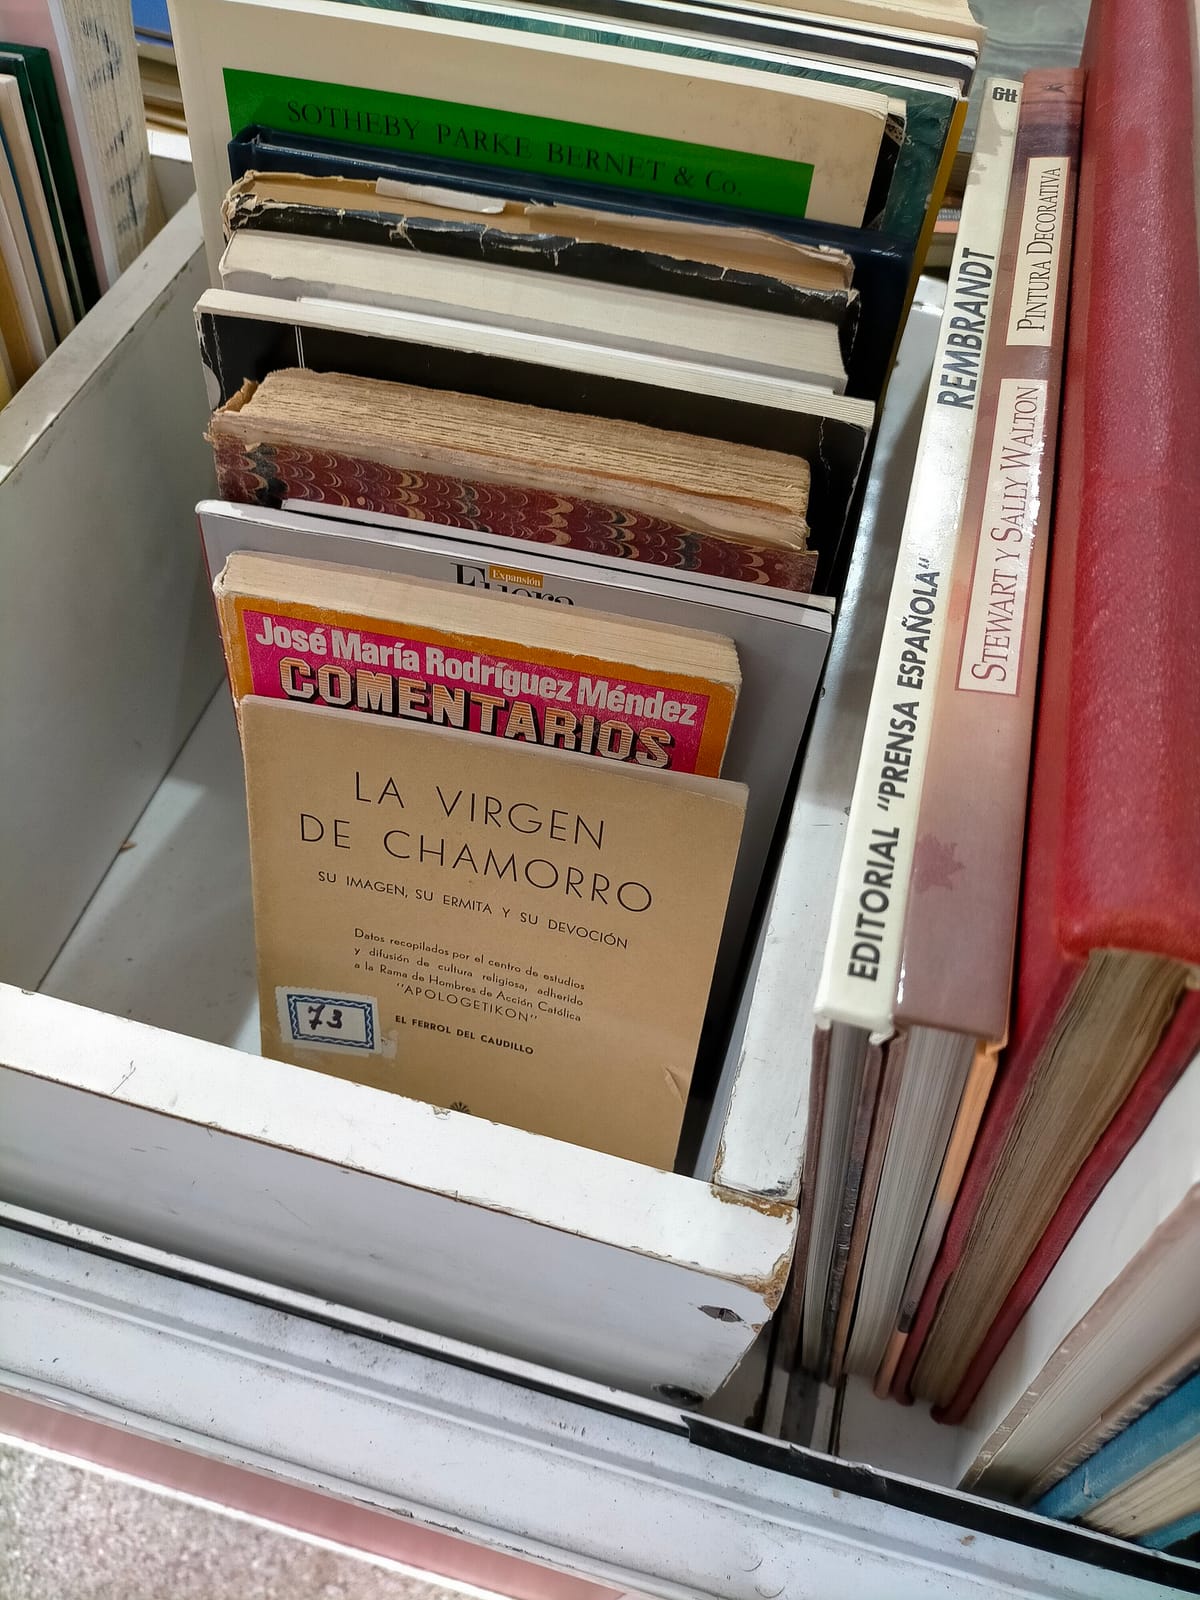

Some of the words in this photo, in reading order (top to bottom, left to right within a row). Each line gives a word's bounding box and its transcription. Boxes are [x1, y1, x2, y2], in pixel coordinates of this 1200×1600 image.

[287, 100, 421, 140] SOTHEBY
[434, 123, 531, 160] PARKE
[547, 142, 666, 181] BERNET
[673, 166, 694, 188] &
[705, 169, 742, 197] Co.
[1026, 167, 1061, 255] DECORATIVA
[937, 247, 995, 410] REMBRANDT
[1016, 260, 1051, 331] PINTURA
[999, 386, 1039, 471] WALTON
[990, 477, 1029, 543] SALLY
[492, 568, 541, 587] Expansión
[994, 548, 1020, 567] Y
[971, 568, 1018, 682] STEWART
[255, 616, 327, 656] José
[331, 629, 420, 673] María
[426, 646, 573, 703] Rodríguez
[577, 676, 698, 726] Méndez
[279, 656, 675, 769] COMENTARIOS
[355, 771, 405, 809] LA
[436, 785, 605, 850] VIRGEN
[300, 813, 351, 850] DE
[383, 829, 653, 913] CHAMORRO
[318, 871, 337, 883] SU
[346, 875, 408, 899] IMAGEN,
[415, 889, 434, 902] SU
[443, 894, 493, 915] ERMITA
[502, 906, 511, 919] Y
[520, 911, 538, 925] SU
[548, 919, 628, 950] DEVOCIÓN
[847, 827, 900, 982] EDITORIAL
[354, 927, 385, 944] Datos
[390, 938, 449, 956] recopilados
[452, 950, 470, 961] por
[474, 953, 484, 964] el
[488, 959, 521, 974] centro
[525, 965, 539, 978] de
[543, 973, 585, 991] estudios
[354, 947, 361, 956] y
[369, 947, 410, 963] difusión
[416, 956, 430, 968] de
[438, 963, 473, 978] cultura
[482, 972, 528, 993] religiosa,
[537, 986, 584, 1007] adherido
[365, 961, 374, 972] la
[380, 963, 408, 979] Rama
[411, 971, 425, 982] de
[429, 974, 477, 994] Hombres
[479, 986, 493, 998] de
[496, 990, 533, 1009] Acción
[537, 1001, 581, 1022] Católica
[395, 1015, 407, 1025] EL
[412, 1018, 452, 1035] FERROL
[456, 1028, 476, 1041] DEL
[481, 1034, 535, 1056] CAUDILLO
